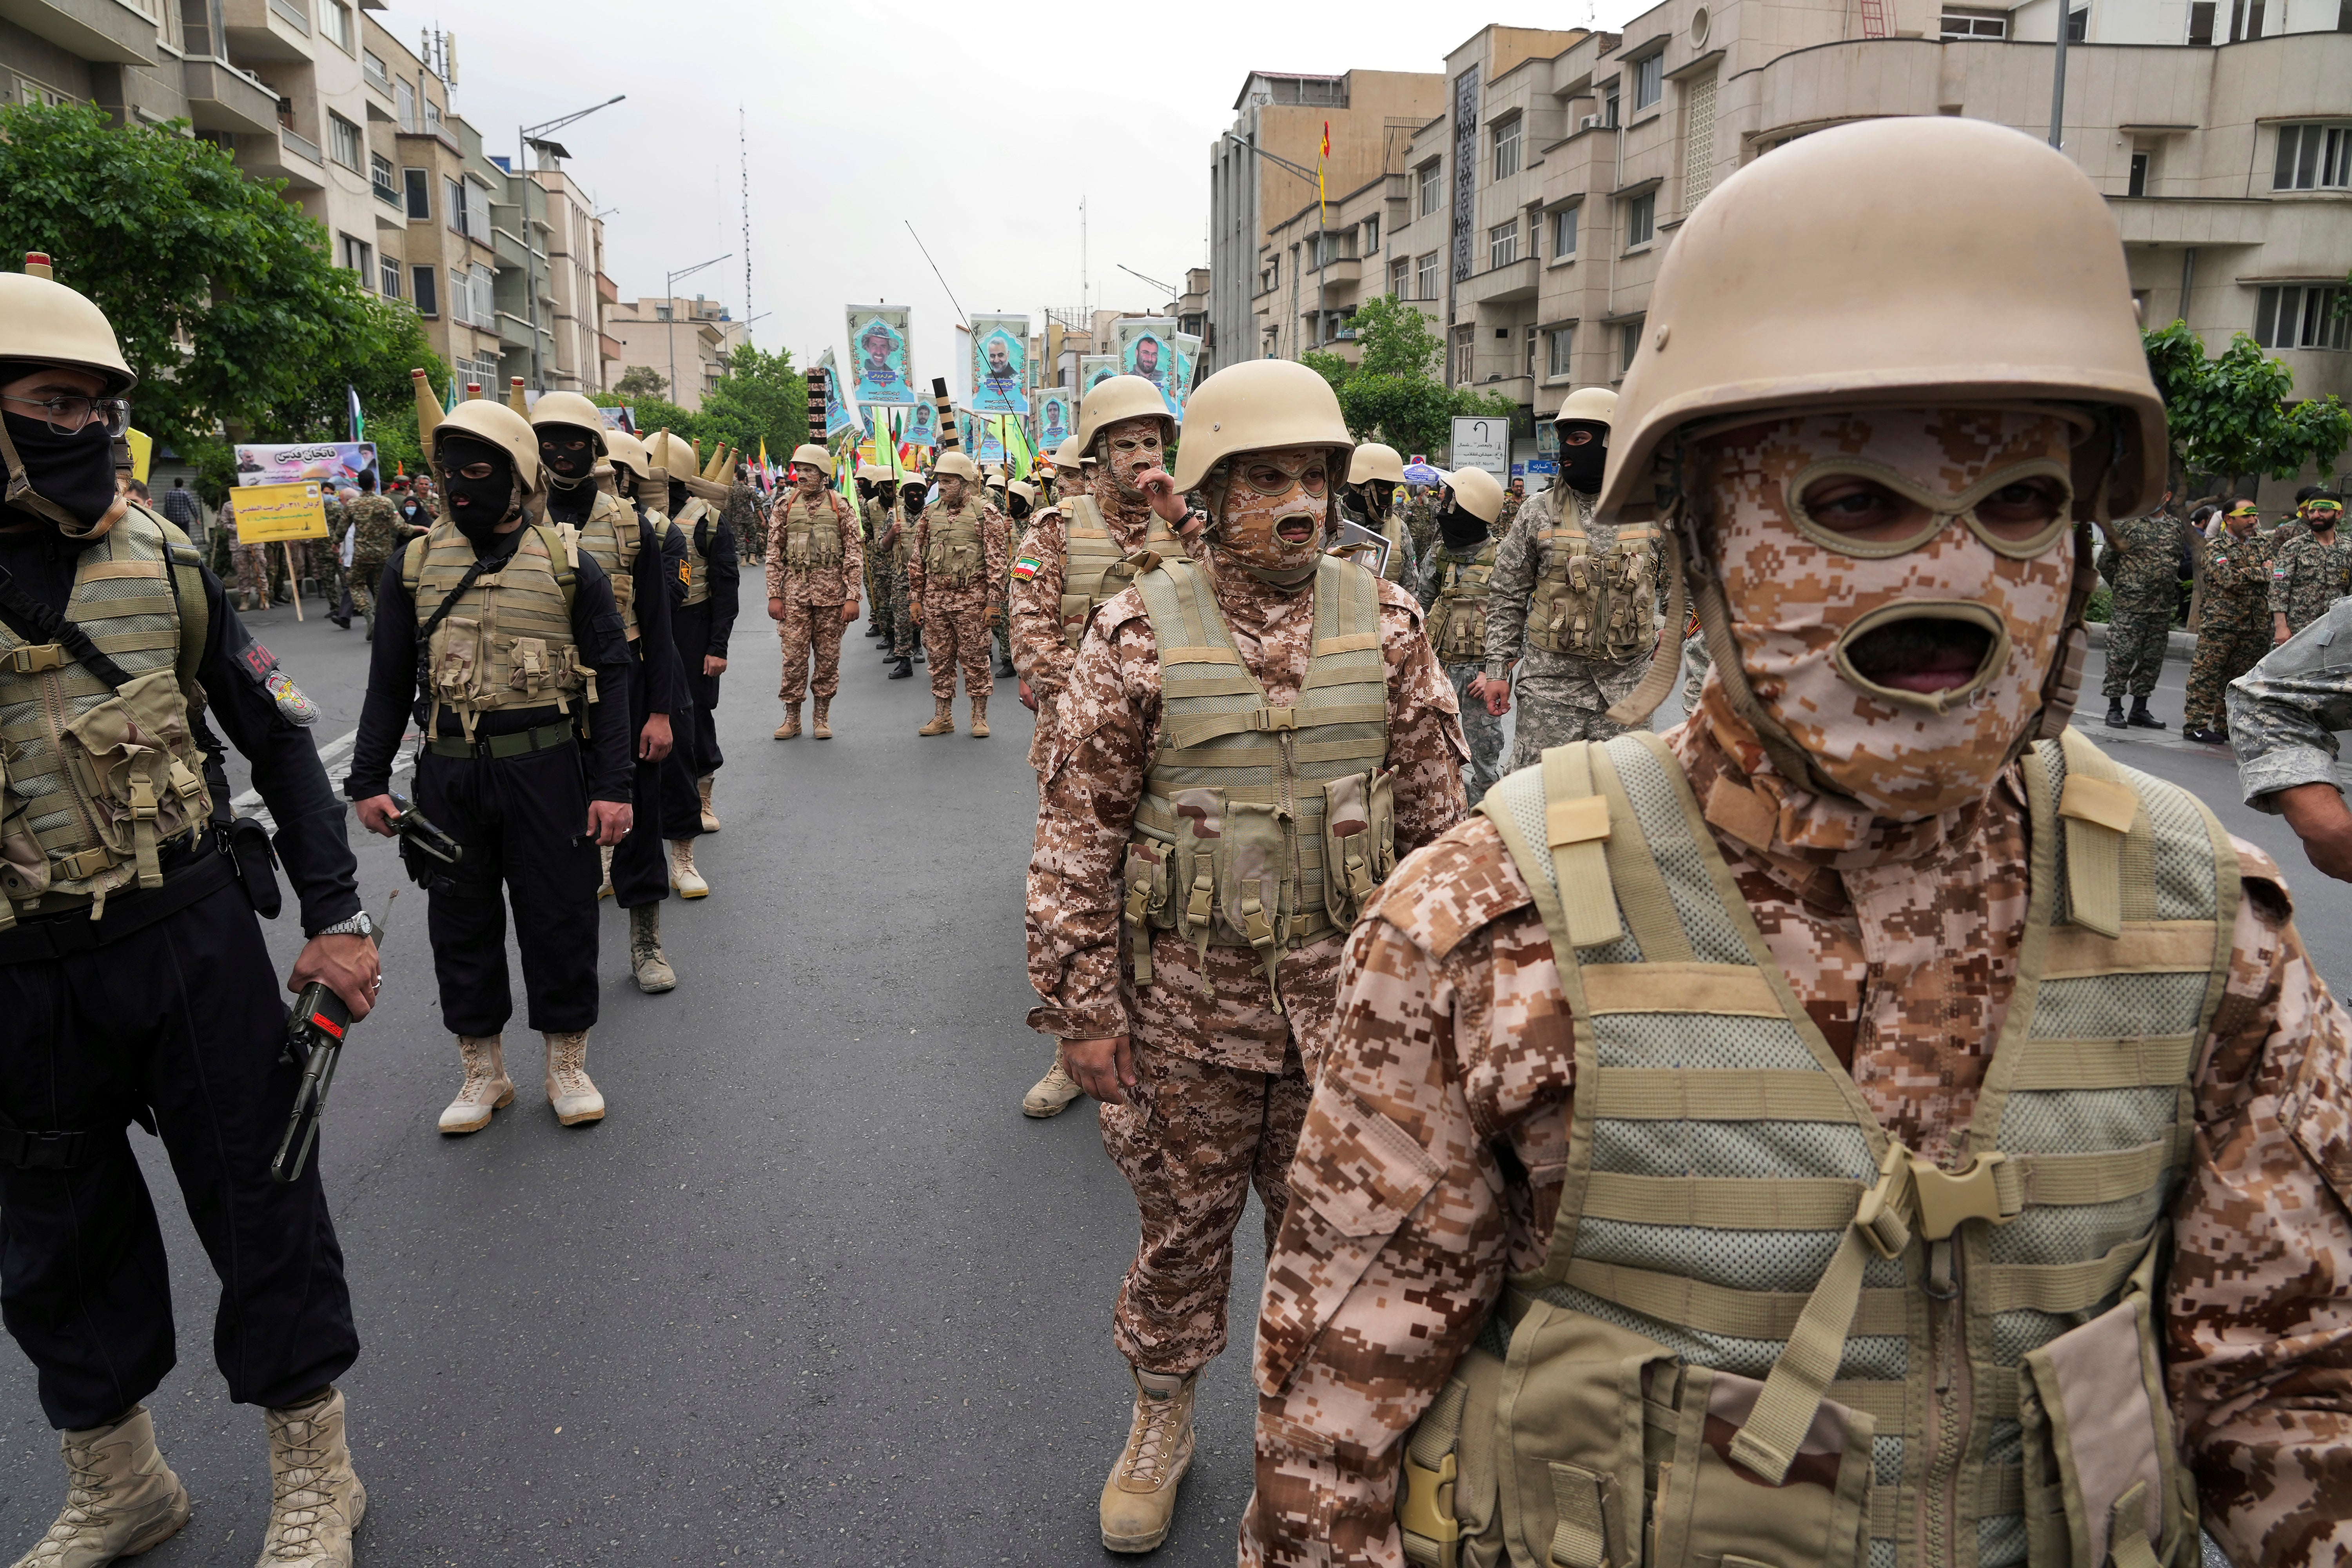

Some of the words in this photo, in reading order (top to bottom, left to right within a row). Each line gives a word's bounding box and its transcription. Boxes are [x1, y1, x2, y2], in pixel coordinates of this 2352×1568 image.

[276, 447, 302, 464] قدس
[303, 446, 337, 463] فاتحان
[303, 501, 320, 509] گردان
